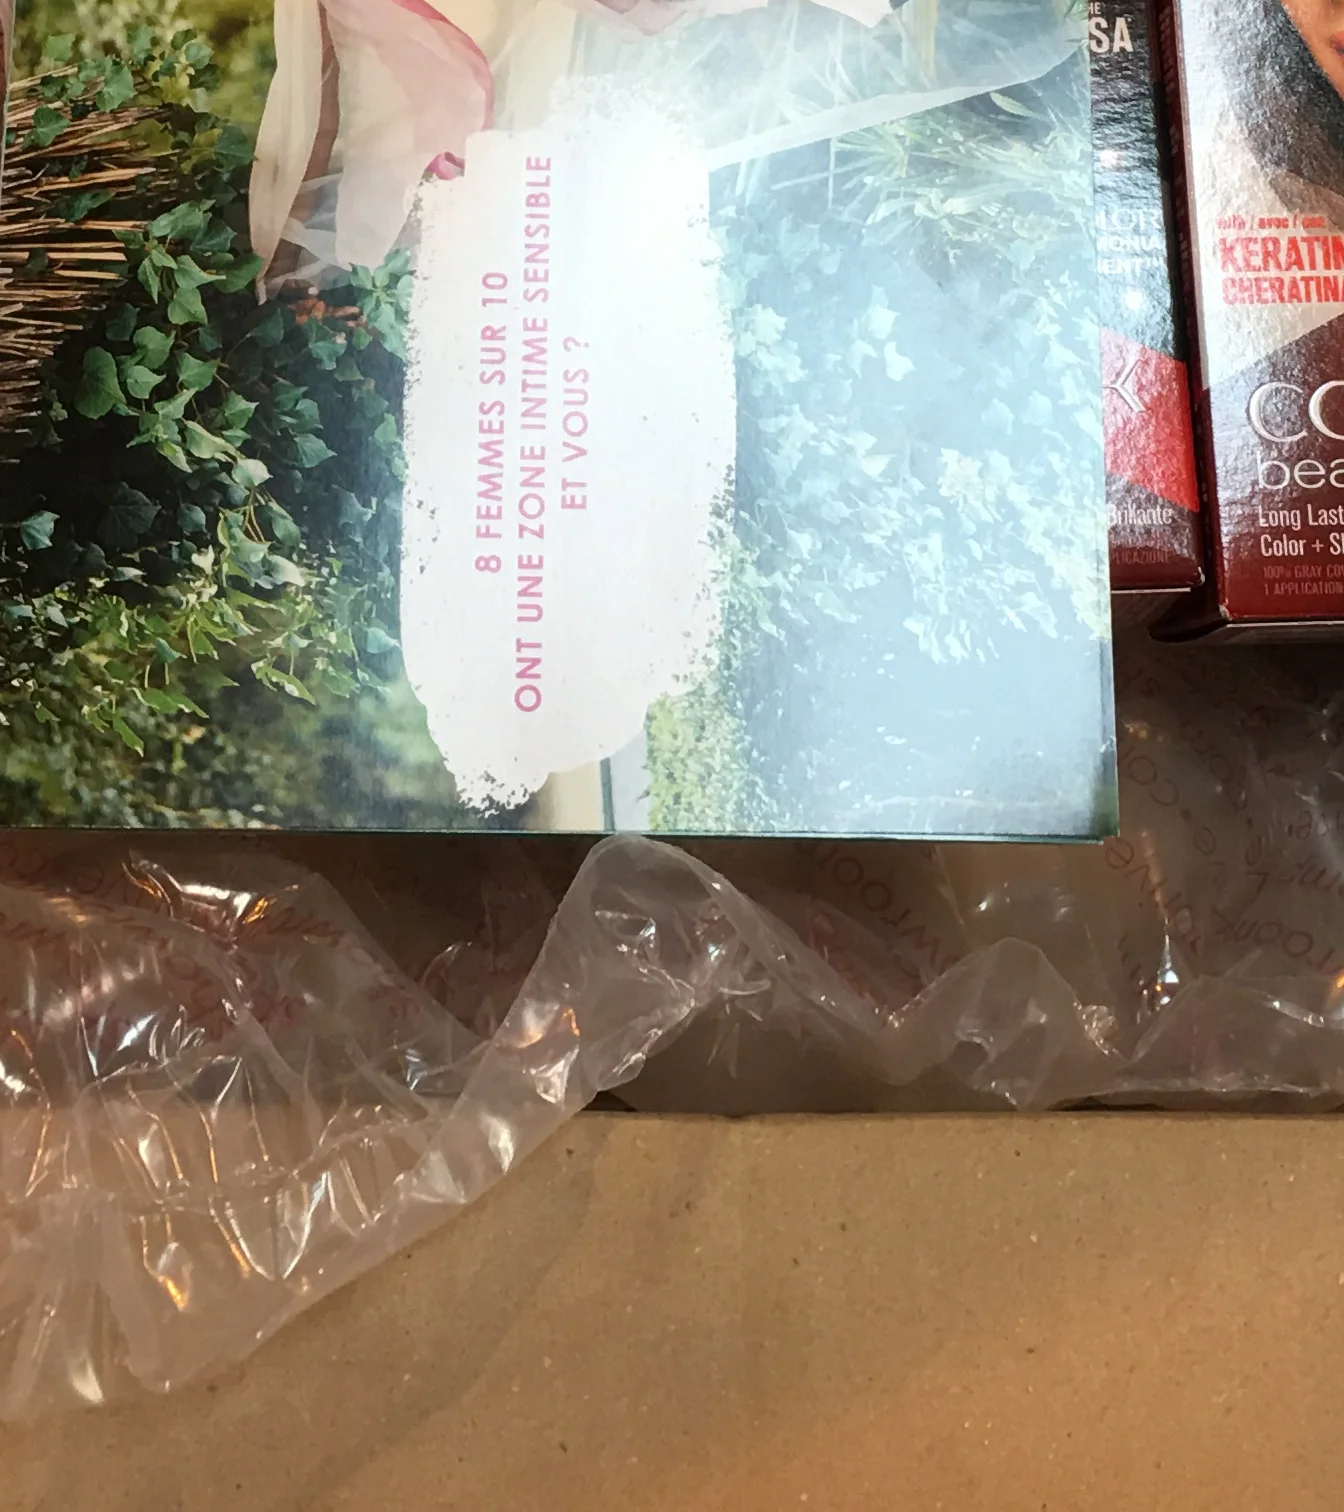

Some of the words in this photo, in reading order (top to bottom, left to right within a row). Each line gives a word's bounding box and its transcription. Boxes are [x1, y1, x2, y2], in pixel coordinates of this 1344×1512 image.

[522, 156, 552, 303] SENSIBLE
[481, 271, 509, 308] 10
[479, 324, 508, 386] SUR
[562, 336, 590, 353] ?
[520, 316, 549, 430] INTIME
[561, 368, 589, 463] VOUS
[475, 400, 505, 540] FEMMES
[518, 445, 546, 540] ZONE
[560, 476, 587, 511] ET
[1258, 504, 1302, 531] Long
[474, 554, 502, 574] 8
[1260, 533, 1307, 557] Color
[516, 554, 544, 622] UNE
[1273, 582, 1344, 595] APPLICATION
[1293, 563, 1325, 577] GRAY
[514, 637, 543, 713] ONT
